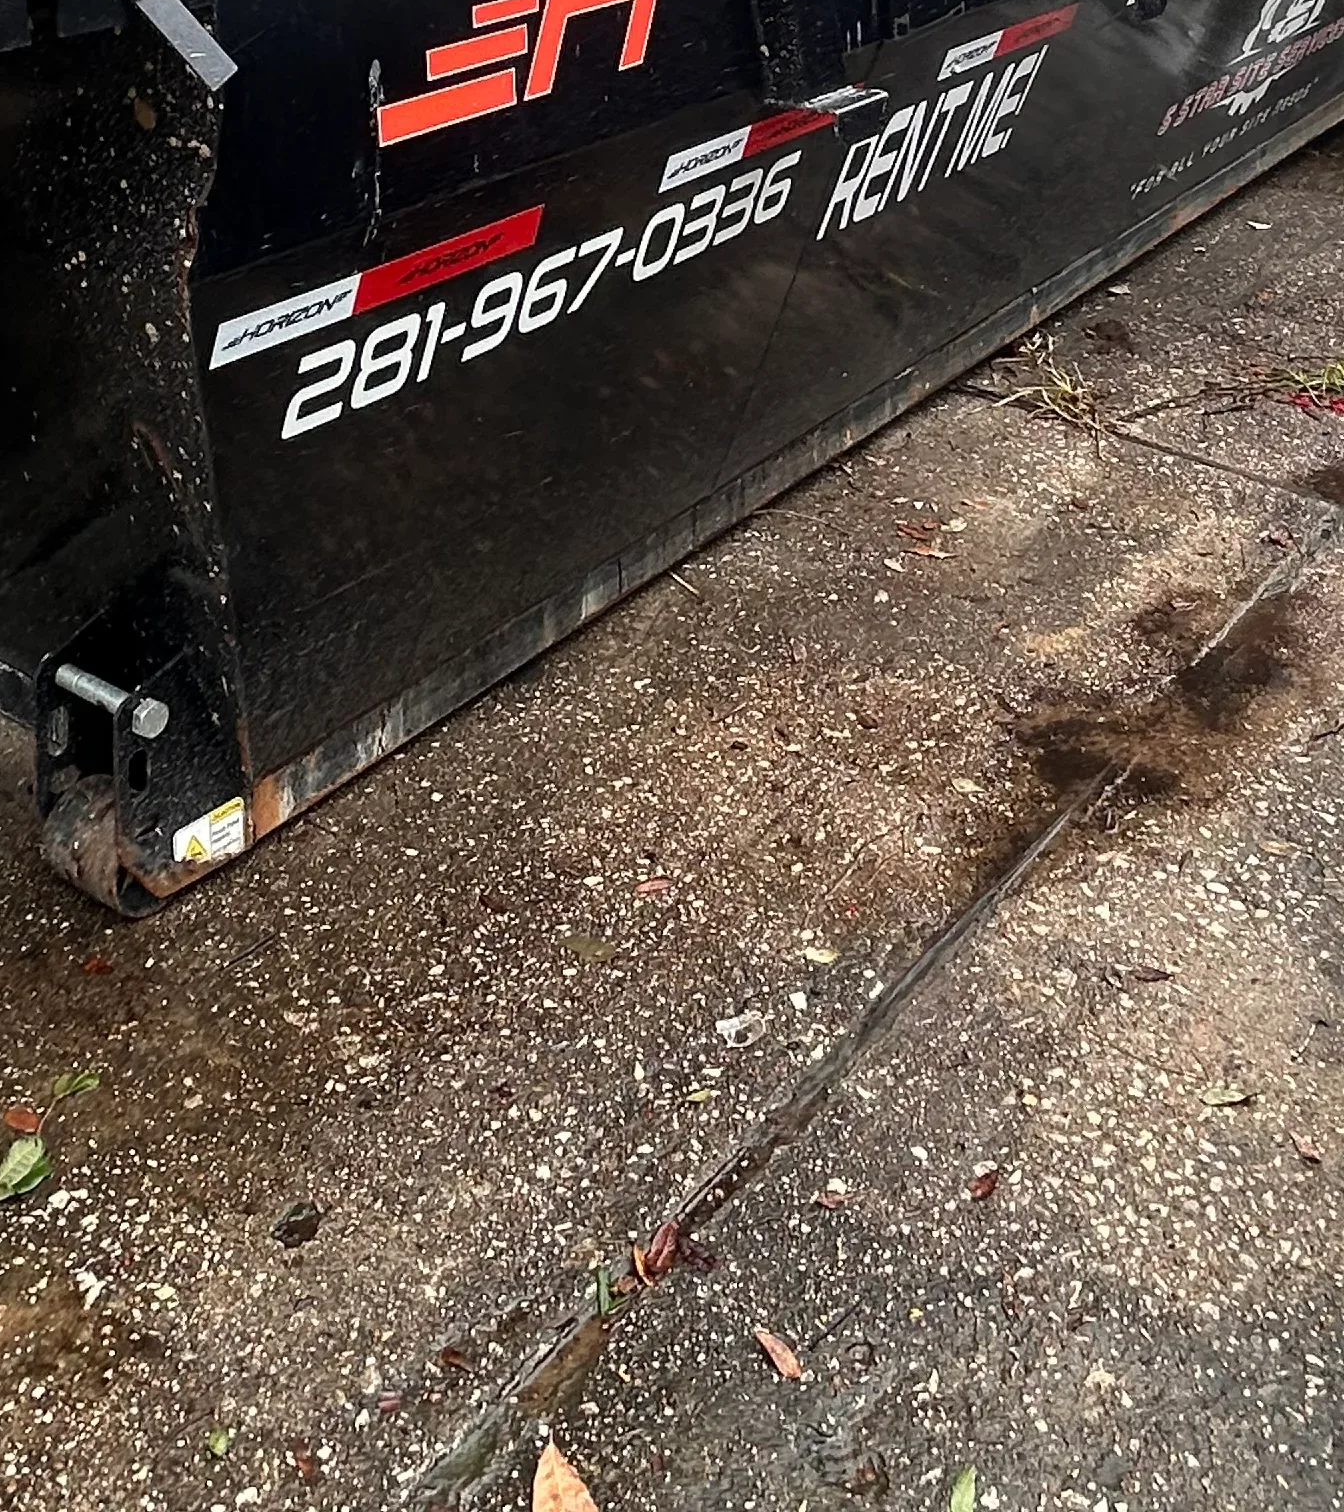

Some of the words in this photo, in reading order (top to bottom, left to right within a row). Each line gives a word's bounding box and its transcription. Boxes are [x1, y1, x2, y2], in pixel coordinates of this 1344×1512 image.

[1226, 51, 1278, 95] SITE
[815, 80, 975, 242] RENT
[944, 44, 1050, 178] ME!
[224, 289, 352, 351] HORIZON
[280, 150, 802, 440] 281-967-0336
